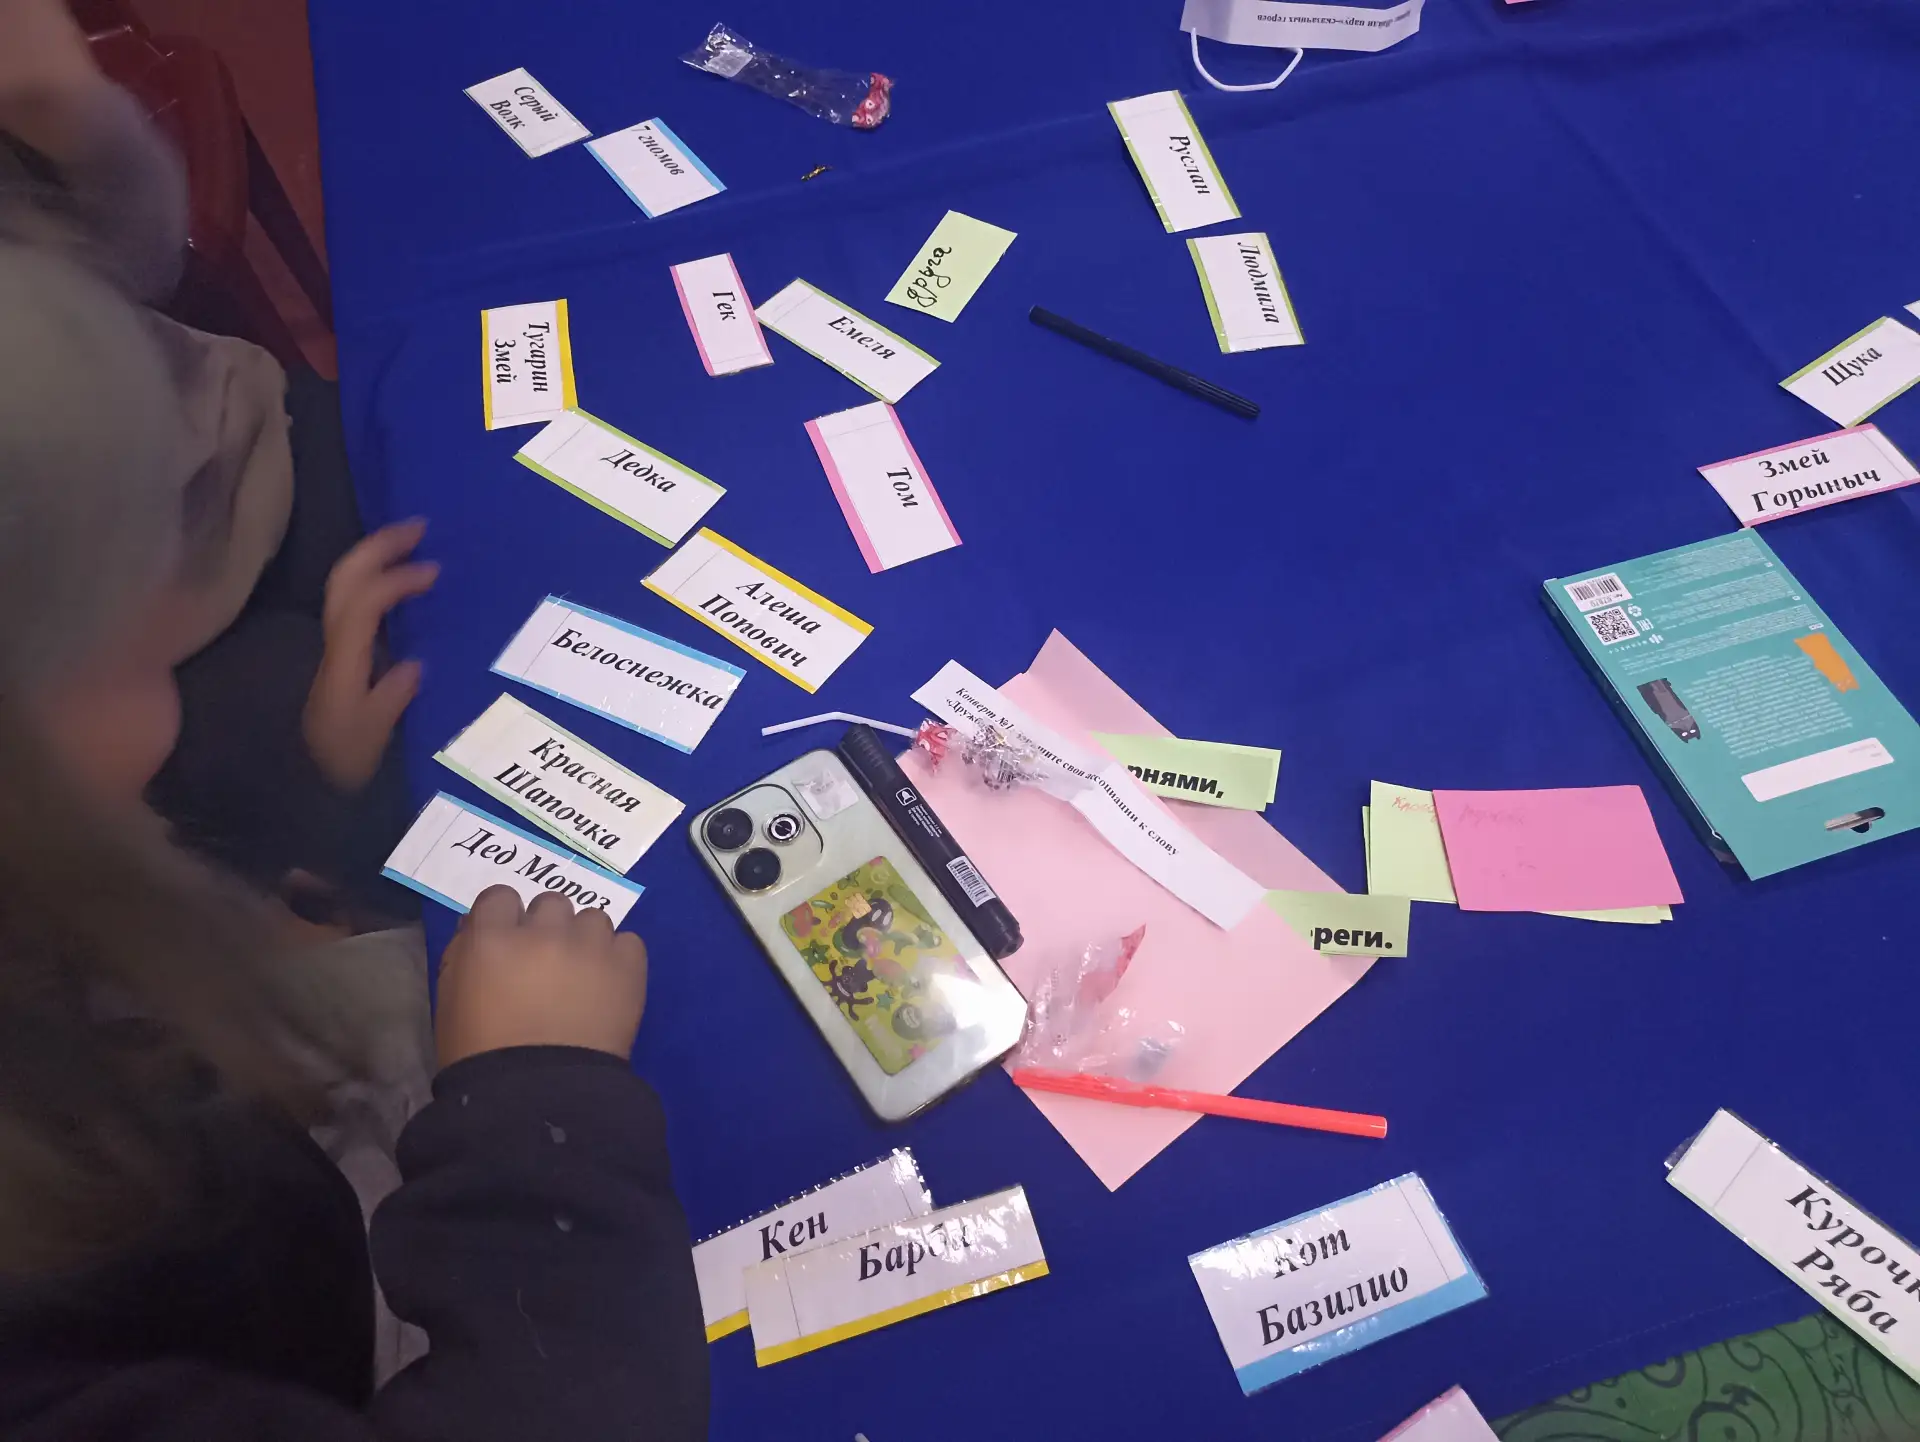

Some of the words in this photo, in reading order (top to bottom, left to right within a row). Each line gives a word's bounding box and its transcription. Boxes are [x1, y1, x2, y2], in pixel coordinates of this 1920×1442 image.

[490, 100, 526, 130] Волк
[514, 86, 560, 122] Серый
[638, 135, 684, 176] гномов
[1169, 134, 1210, 196] Руслан
[712, 291, 736, 322] Гек
[1237, 242, 1279, 324] Людмила
[494, 338, 516, 385] Змей
[523, 322, 550, 394] Тугарин
[828, 316, 896, 360] Емеля
[1821, 345, 1883, 386] Щука
[600, 448, 677, 494] Дедка
[1758, 448, 1830, 478] Змей
[886, 466, 920, 509] Том
[1750, 468, 1882, 513] Горыныч
[734, 576, 823, 636] Алеша
[698, 592, 808, 670] Попович
[550, 628, 724, 710] Белоснежка
[529, 736, 642, 814] Красная
[956, 687, 996, 718] Конверт
[1148, 830, 1180, 856] слову
[493, 762, 621, 850] Шапочка
[450, 827, 518, 865] Дед
[1310, 927, 1393, 951] реги.
[758, 1211, 829, 1262] Кен
[1256, 1266, 1409, 1346] Базилио
[1790, 1246, 1898, 1334] Ряба
